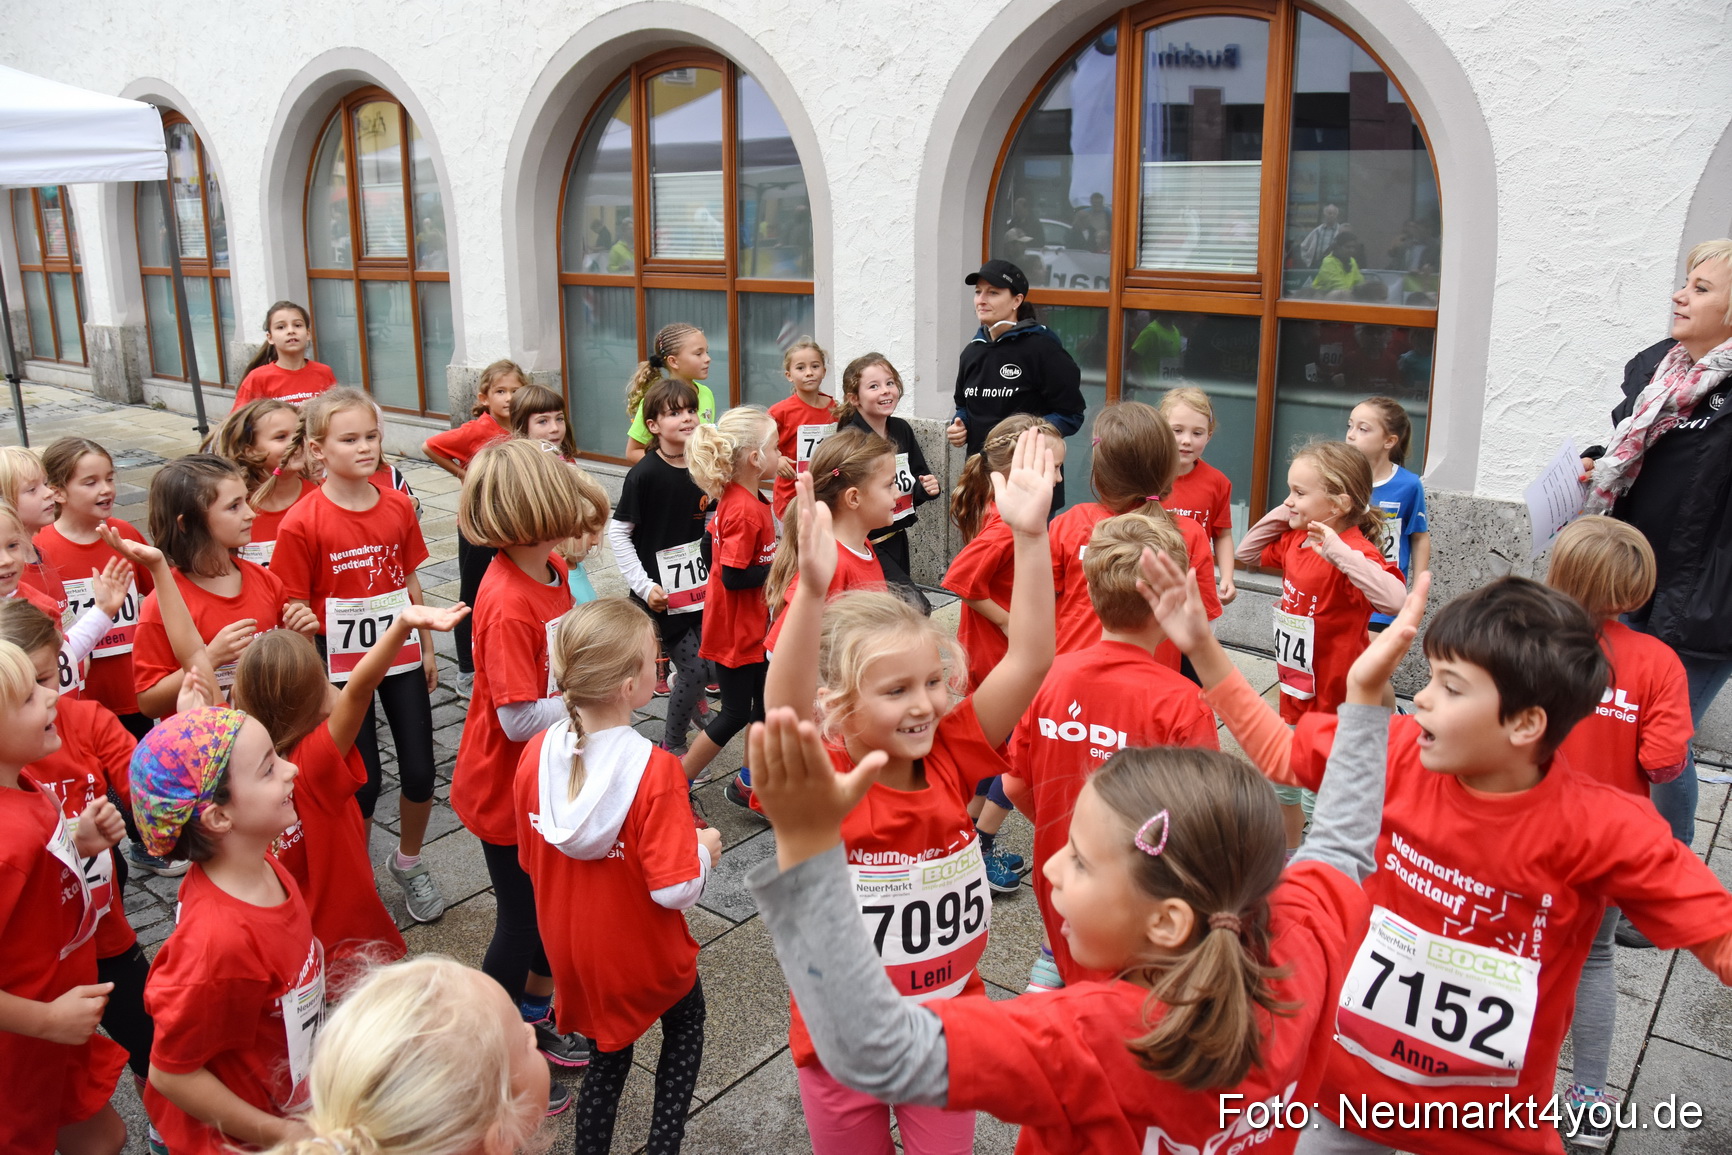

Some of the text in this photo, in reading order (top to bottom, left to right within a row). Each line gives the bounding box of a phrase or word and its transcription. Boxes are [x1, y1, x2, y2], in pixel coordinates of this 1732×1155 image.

[964, 386, 978, 398] get
[922, 845, 981, 885] BOCK
[1384, 853, 1466, 916] Stadtlauf
[1391, 831, 1496, 899] Neumarkter
[856, 882, 913, 893] NeuerMarkt
[862, 878, 985, 958] 7095
[1378, 928, 1417, 956] NeuerMarkt
[911, 960, 952, 990] Leni
[1427, 940, 1522, 985] BOCK
[1361, 950, 1514, 1060] 7152
[1390, 1039, 1449, 1074] Anna
